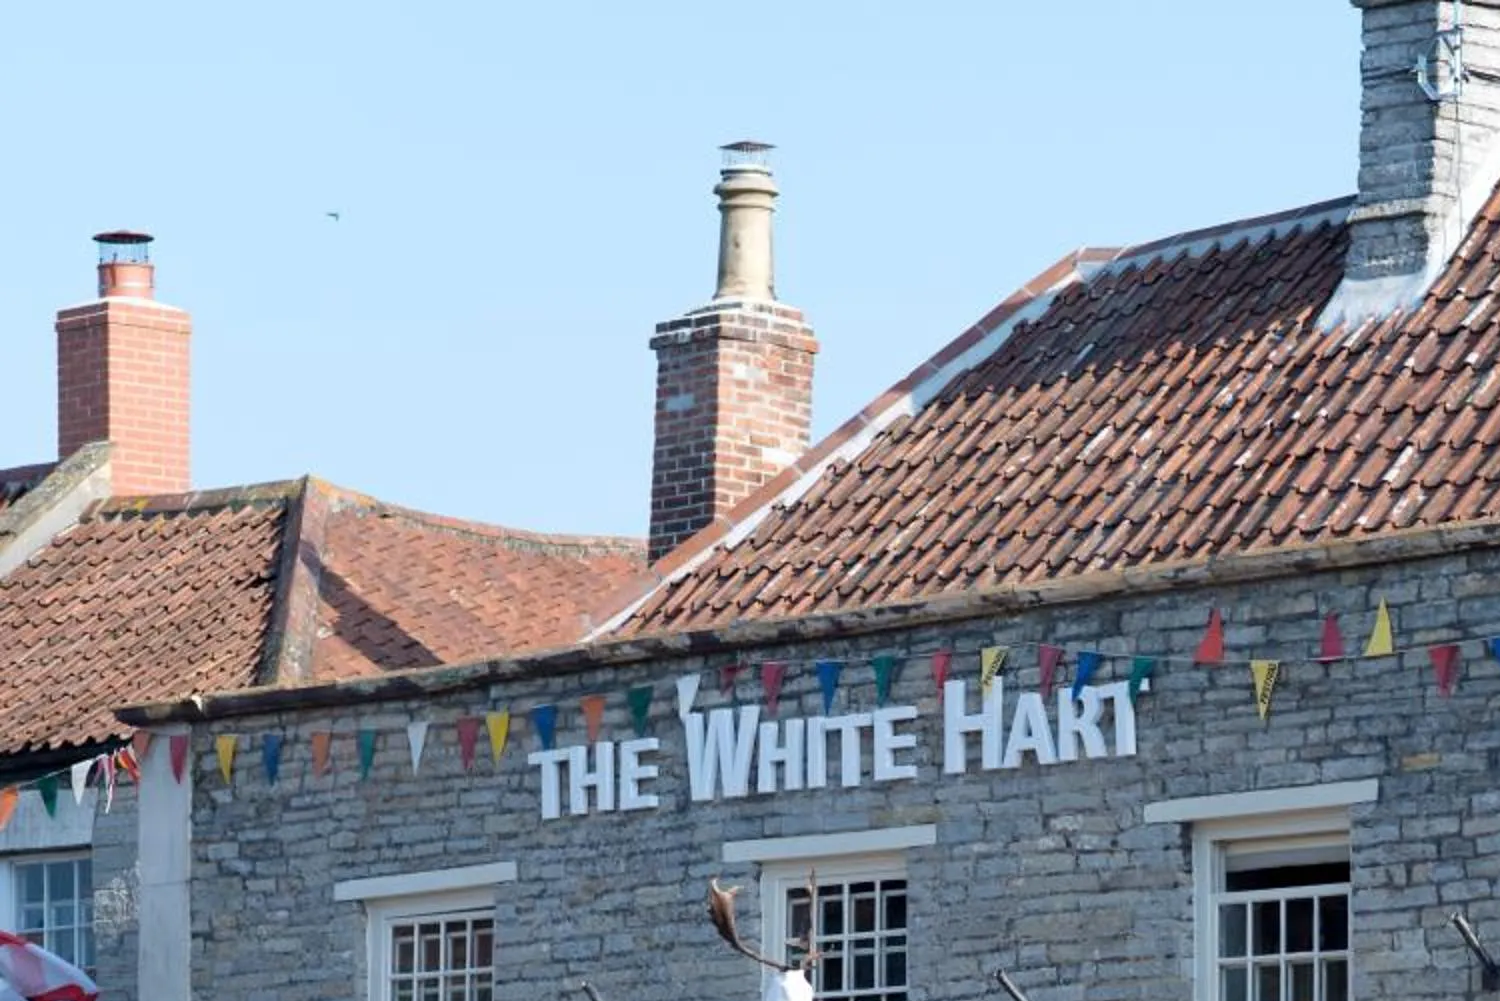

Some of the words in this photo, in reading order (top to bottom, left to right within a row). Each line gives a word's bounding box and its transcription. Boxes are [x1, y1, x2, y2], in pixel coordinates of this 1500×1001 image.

[528, 737, 660, 820] THE
[677, 675, 918, 801] WHITE
[943, 676, 1150, 774] HART
